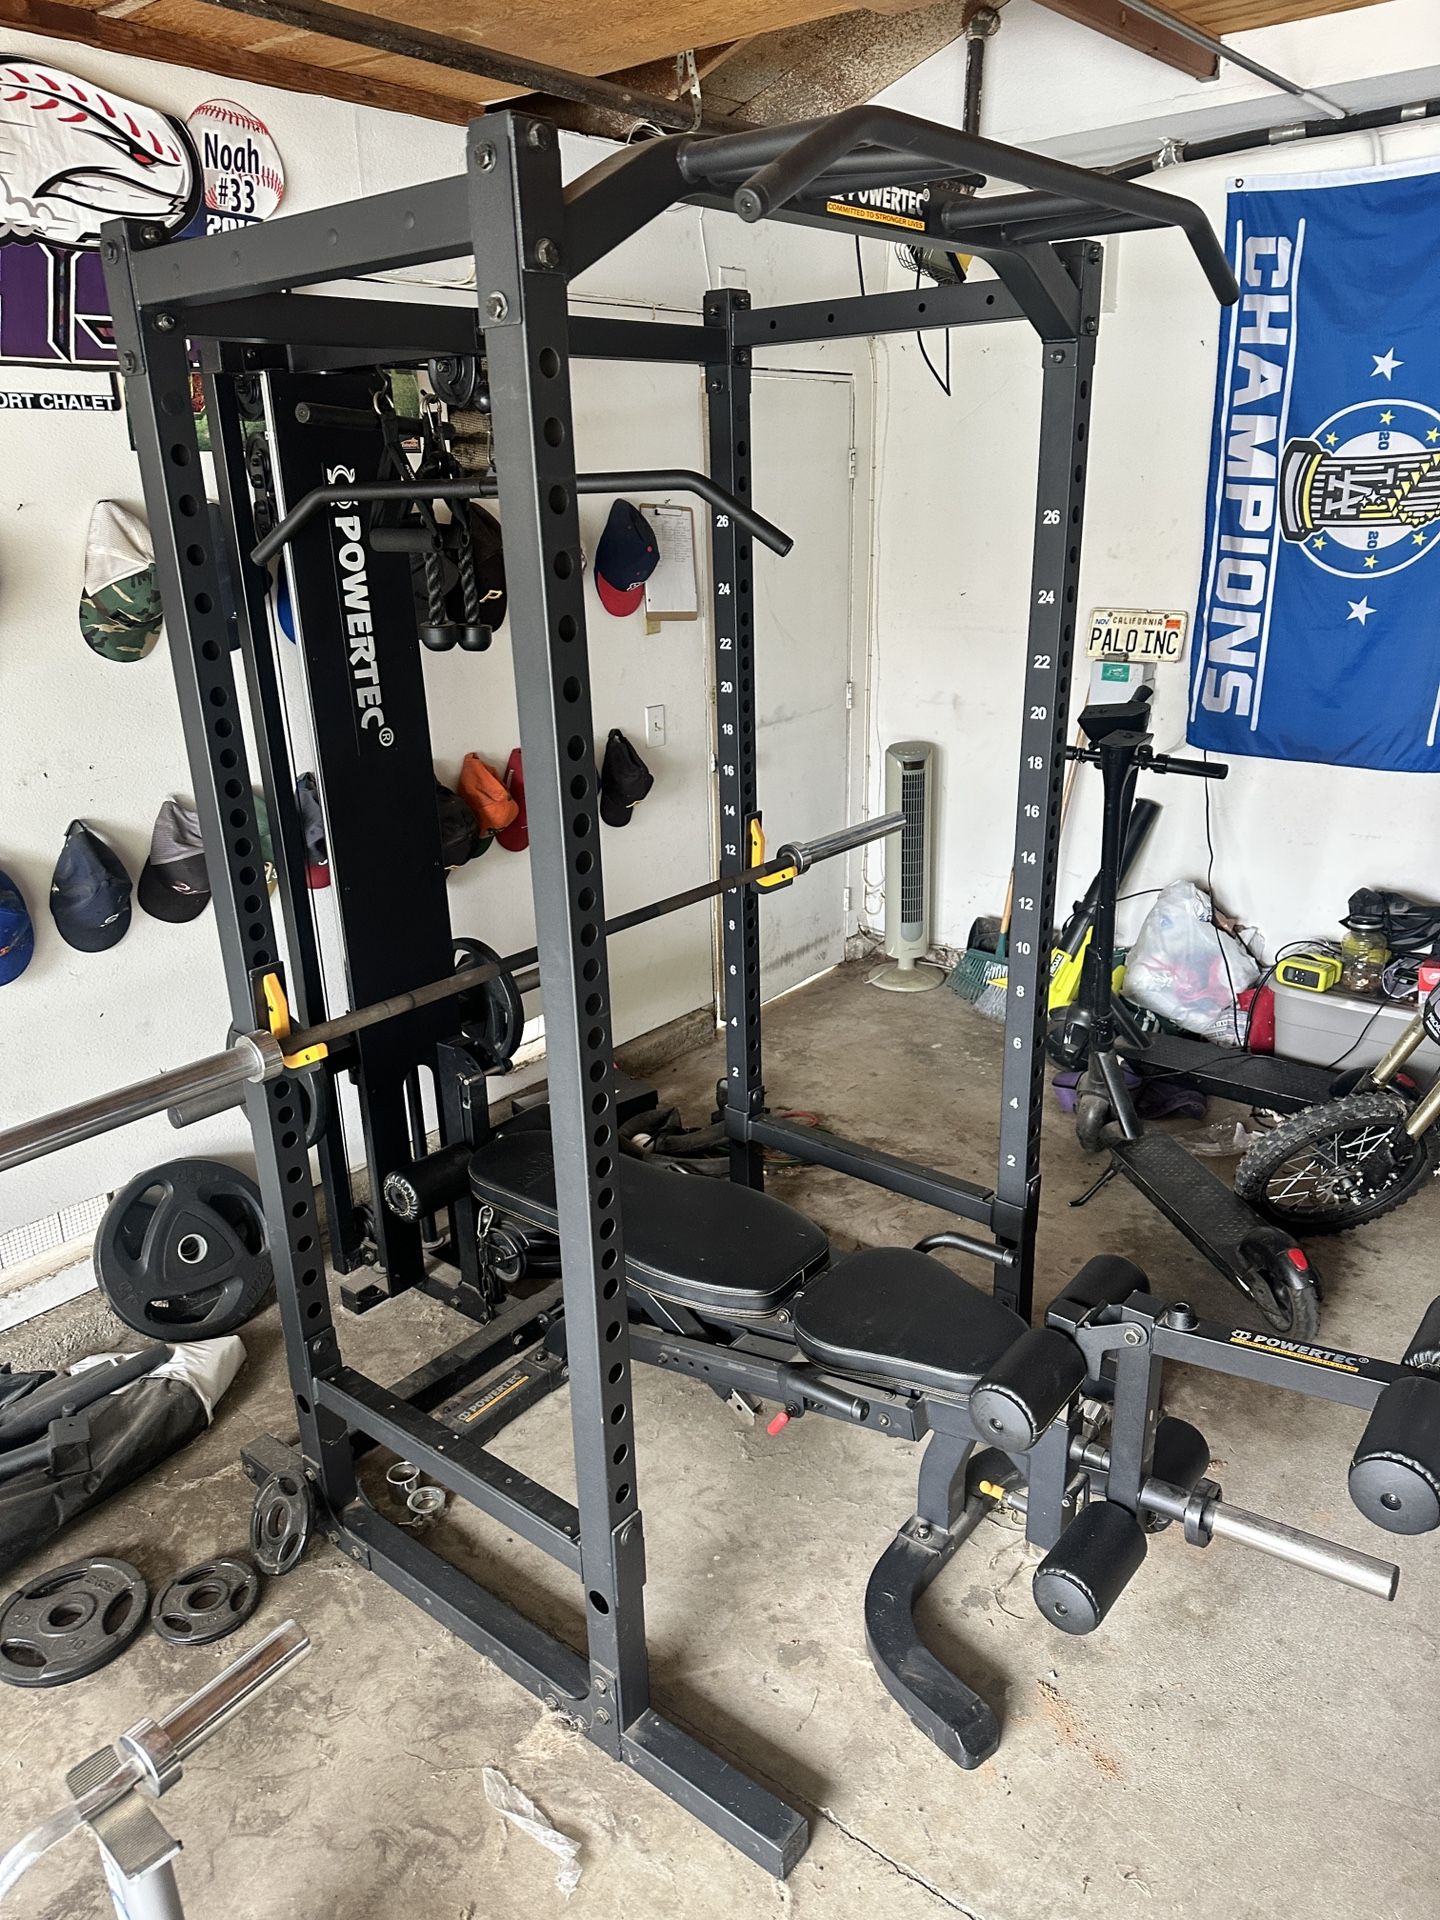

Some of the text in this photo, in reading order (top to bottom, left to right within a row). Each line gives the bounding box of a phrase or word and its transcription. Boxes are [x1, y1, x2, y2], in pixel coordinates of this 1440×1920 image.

[205, 132, 259, 174] Noah
[219, 177, 255, 213] #33
[828, 203, 923, 229] COMMITTED TO STRONGER LIVES
[40, 393, 115, 411] CHALET
[1378, 432, 1390, 450] 20
[1202, 236, 1292, 716] CHAMPIONS
[716, 514, 729, 528] 26
[1042, 509, 1061, 525] 26
[1367, 531, 1379, 549] 20
[718, 582, 731, 595] 24
[1037, 589, 1056, 605] 24
[1112, 616, 1163, 626] CALIFORNIA
[719, 637, 732, 650] 22
[1089, 627, 1179, 655] PALO INC
[1033, 654, 1051, 670] 22
[720, 680, 733, 694] 20
[1029, 705, 1047, 721] 20
[721, 723, 734, 736] 18
[1027, 755, 1043, 770] 18
[722, 764, 735, 777] 16
[723, 804, 736, 817] 14
[1023, 803, 1040, 819] 16
[724, 843, 737, 856] 12
[1020, 850, 1037, 866] 14
[1017, 896, 1034, 911] 12
[728, 919, 736, 931] 8
[1015, 940, 1031, 956] 10
[729, 964, 737, 976] 6
[1015, 984, 1025, 1000] 8
[730, 1016, 738, 1028] 4
[1012, 1037, 1022, 1050] 6
[732, 1066, 740, 1078] 2
[1009, 1096, 1019, 1111] 4
[1006, 1154, 1016, 1168] 2
